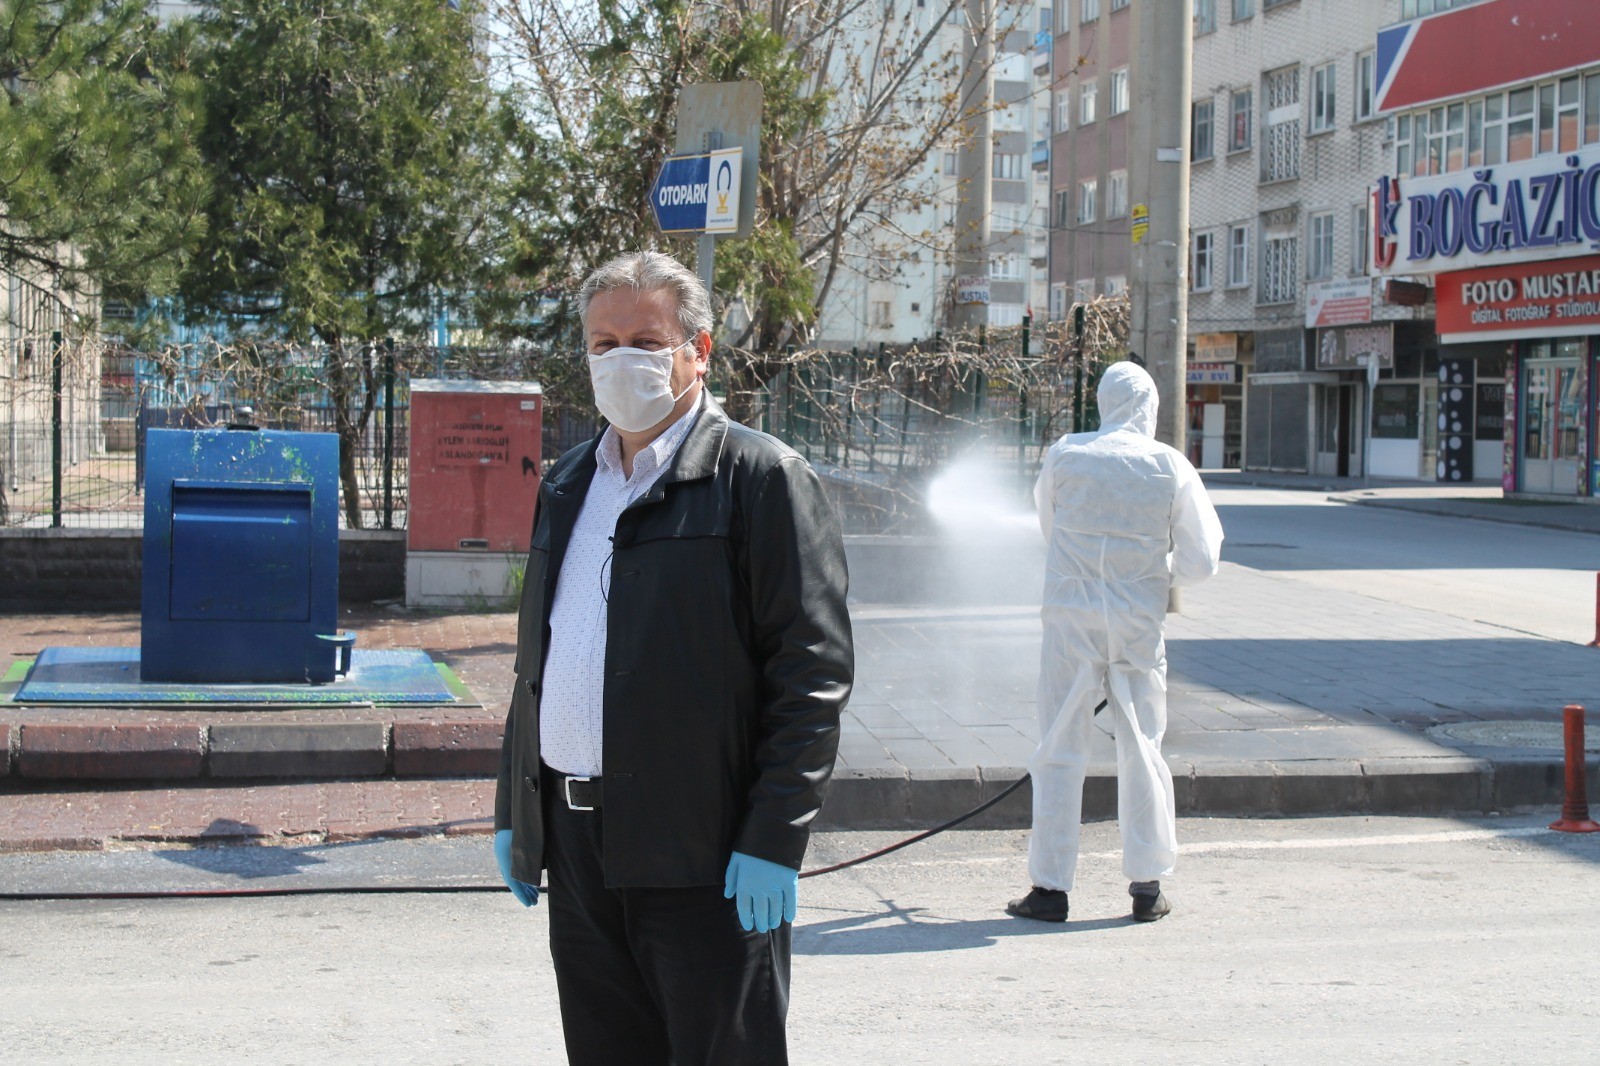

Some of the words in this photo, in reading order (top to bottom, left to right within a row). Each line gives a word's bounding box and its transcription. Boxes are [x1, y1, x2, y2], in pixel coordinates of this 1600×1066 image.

[659, 183, 708, 207] OTOPARK
[1462, 279, 1514, 305] FOTO
[1471, 305, 1502, 324] DİGİTAL
[1505, 303, 1550, 322] FOTOĞRAF
[1556, 298, 1600, 318] STÜDYOL
